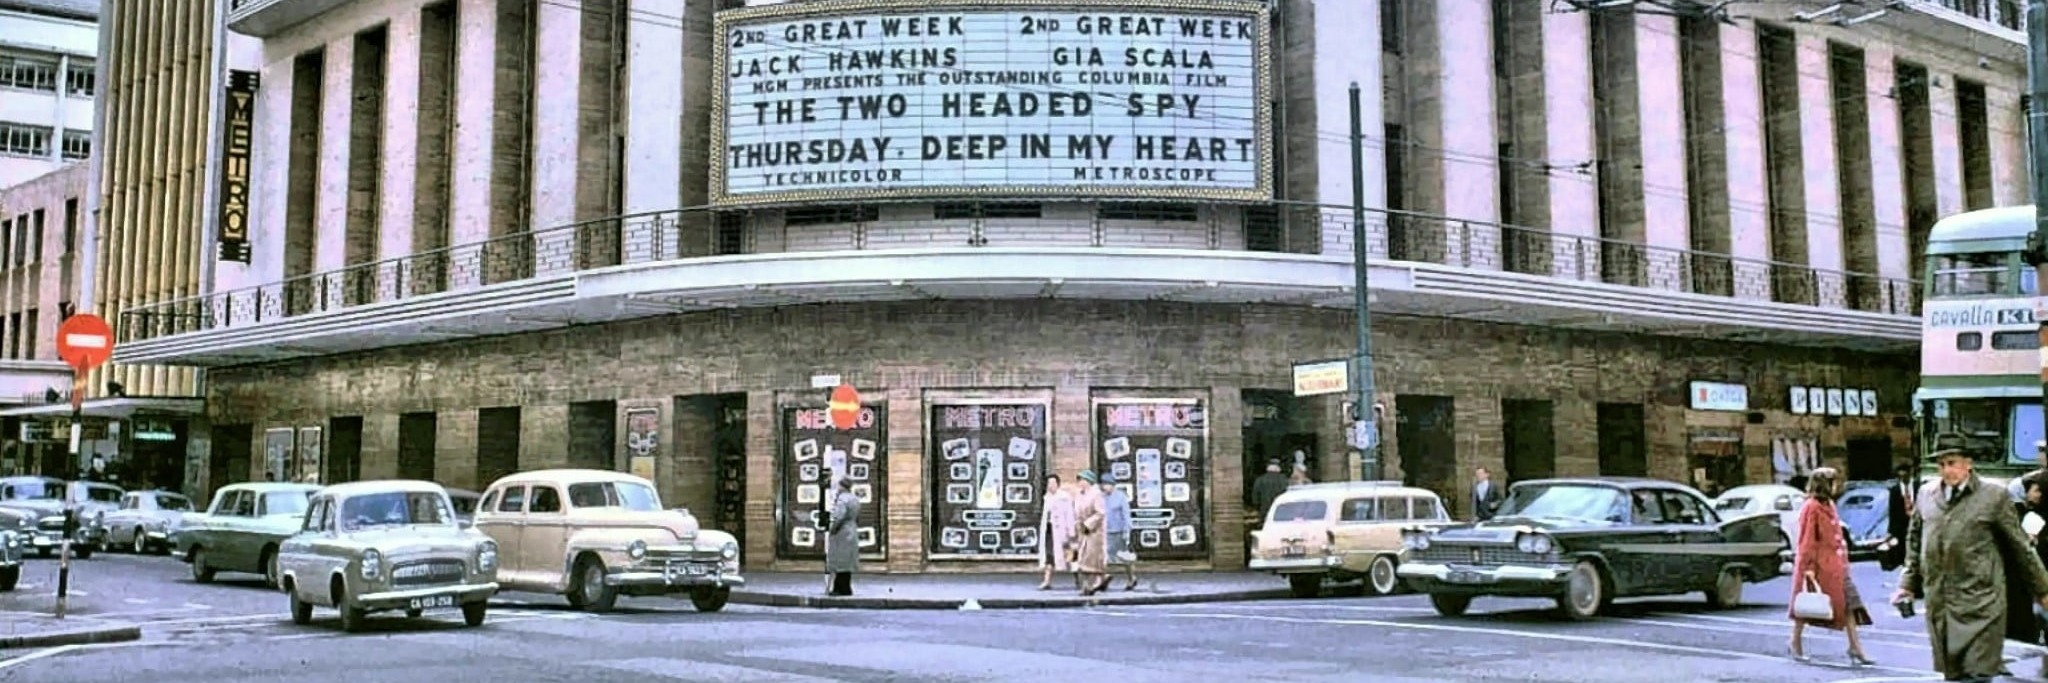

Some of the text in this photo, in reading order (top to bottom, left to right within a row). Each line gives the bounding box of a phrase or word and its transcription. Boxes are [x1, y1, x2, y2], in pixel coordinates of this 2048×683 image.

[731, 16, 963, 47] 2ND GREAT WEEK
[1020, 16, 1251, 39] 2ND GREAT WEEK
[731, 47, 958, 78] JACK HAWKINS
[1053, 47, 1214, 69] GIA SCALA
[753, 70, 1228, 94] MGM PRESENTS THE OUTSTANDING COLUMBIA FILM
[754, 91, 1200, 126] THE TWO HEADED SPY
[921, 134, 1007, 161] DEEP
[1020, 133, 1050, 159] IN
[1068, 134, 1115, 160] MY
[1136, 135, 1252, 162] HEART
[226, 92, 251, 238] METRO
[1074, 167, 1217, 182] METROSCOPE
[763, 168, 902, 186] TECHNICOLOR
[1794, 391, 1876, 410] PINNS
[796, 407, 874, 429] MEO
[945, 405, 1034, 428] METRO
[1106, 405, 1187, 427] METRO
